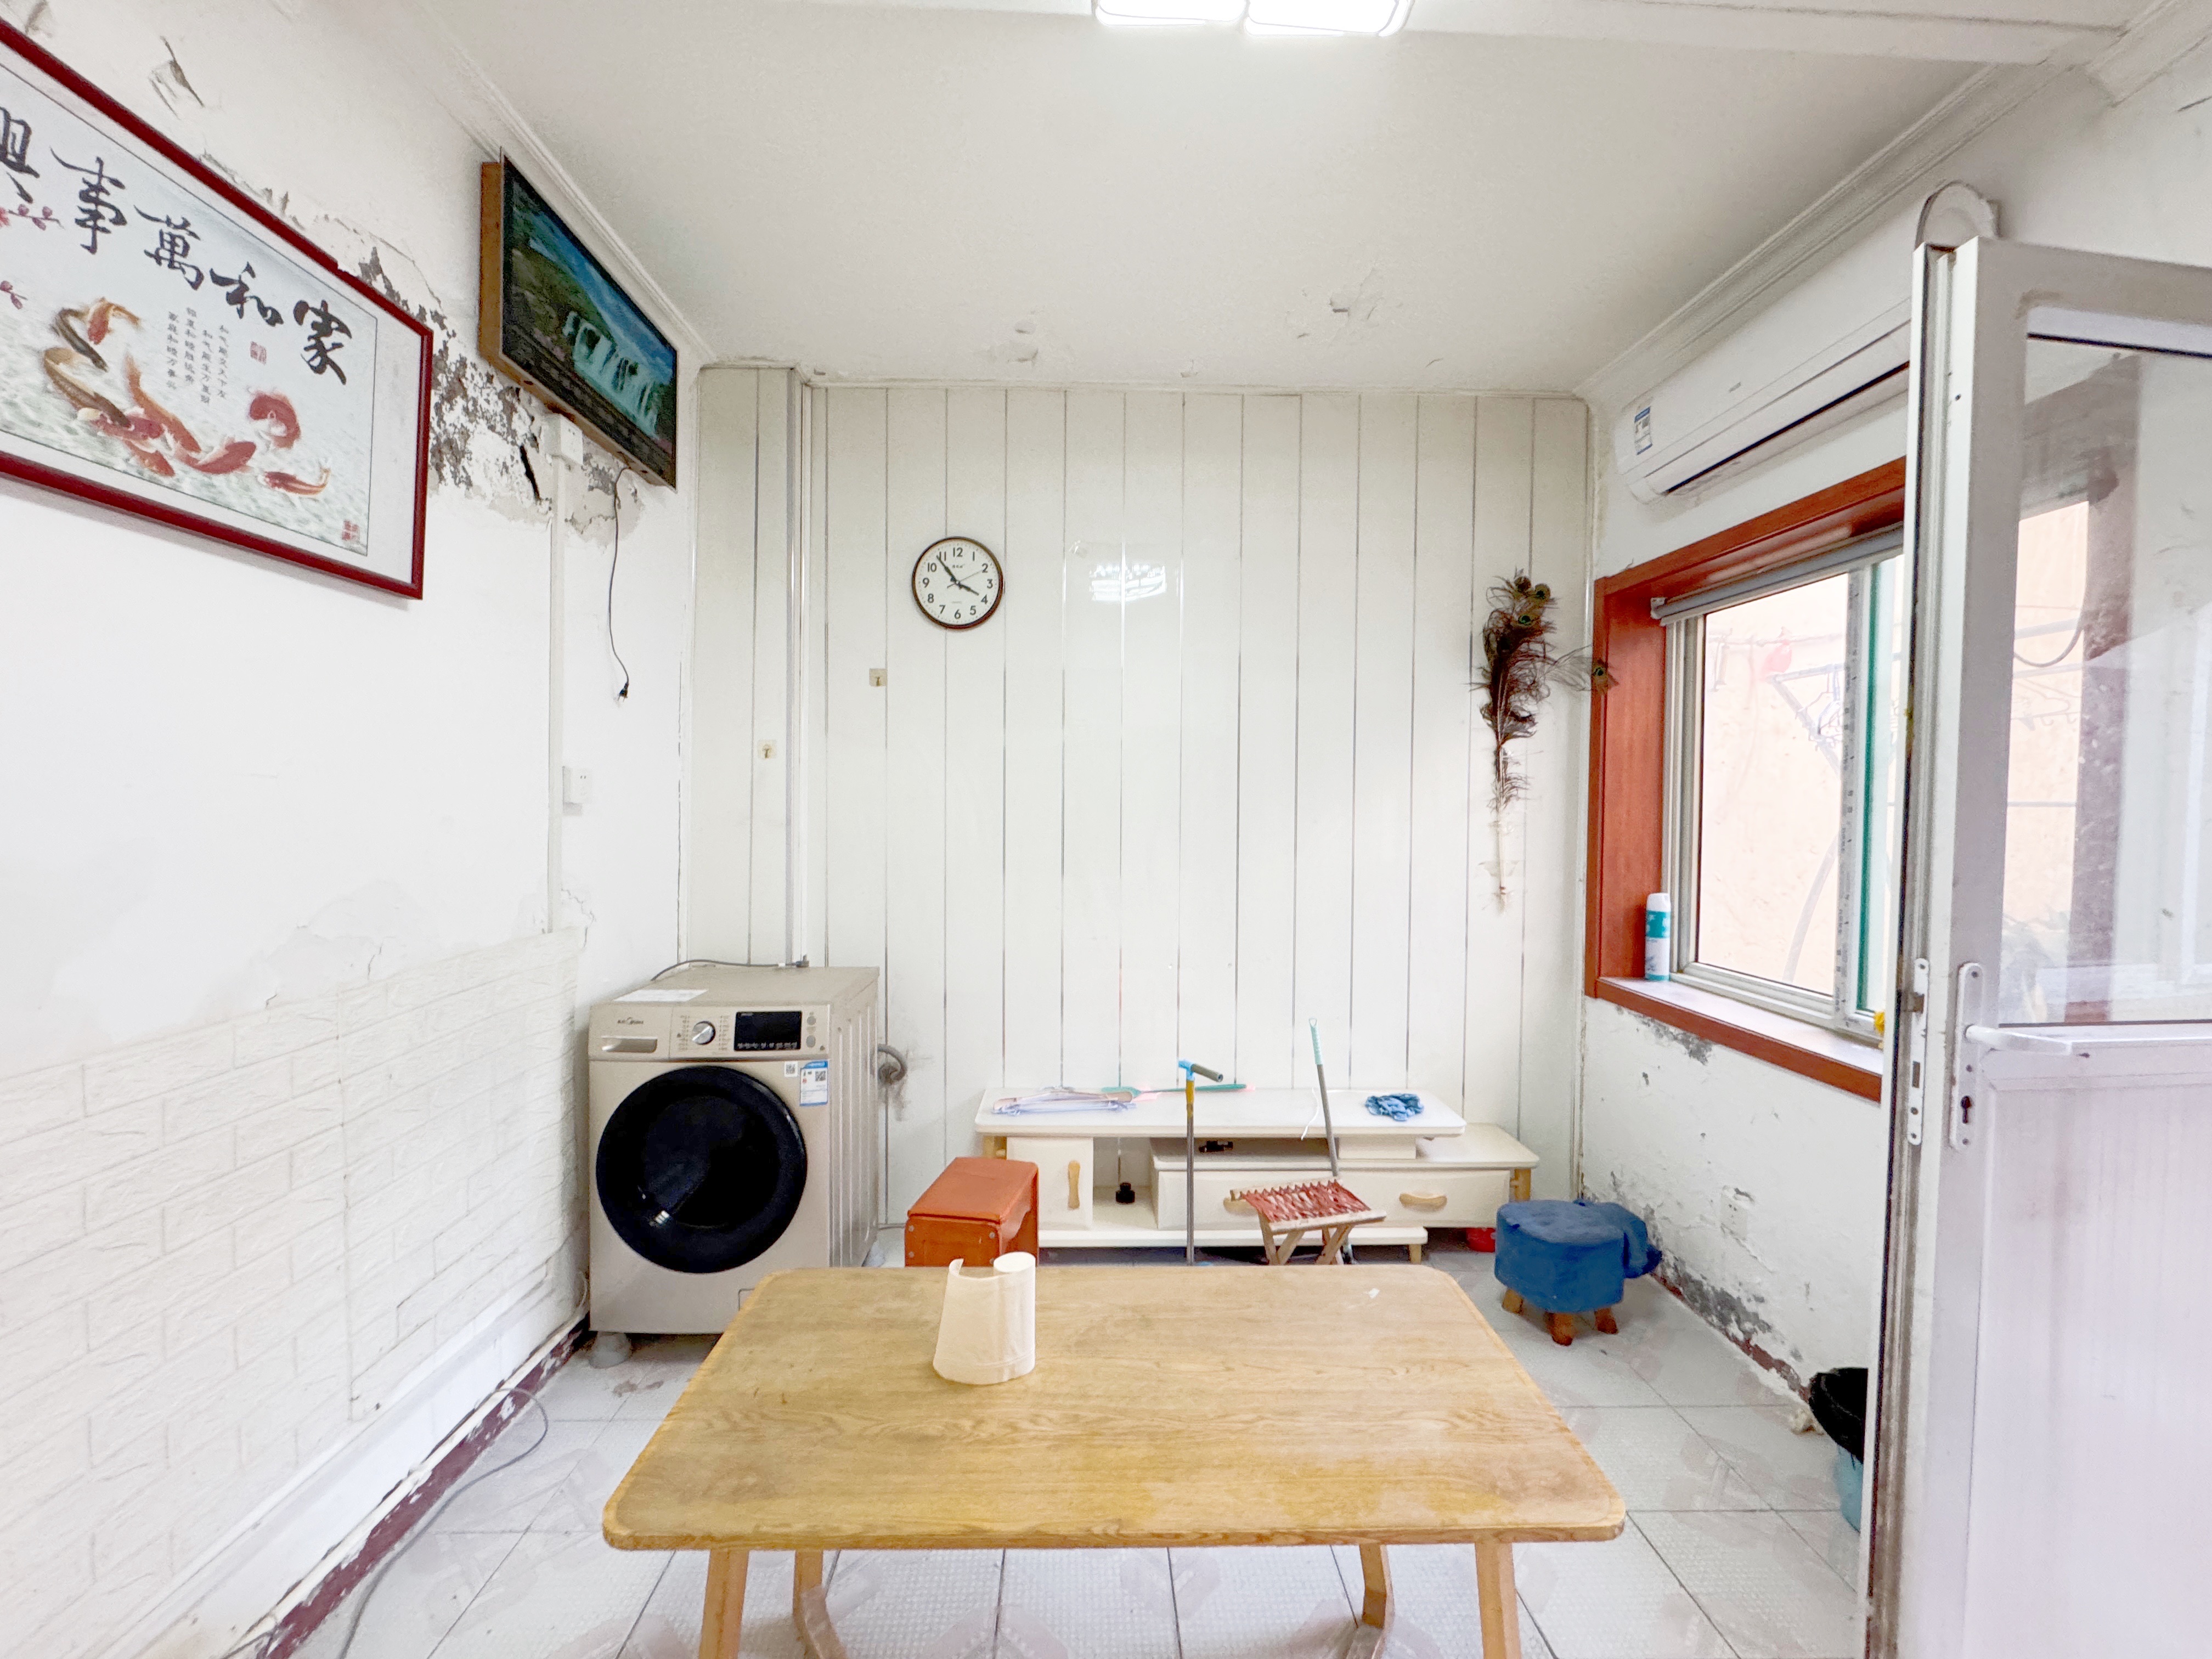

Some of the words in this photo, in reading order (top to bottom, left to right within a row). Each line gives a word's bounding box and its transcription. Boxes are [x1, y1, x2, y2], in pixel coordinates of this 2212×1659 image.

[939, 551, 946, 561] 11
[953, 548, 963, 557] 12
[973, 551, 975, 561] 1
[928, 562, 937, 572] 10
[982, 563, 988, 573] 2
[923, 578, 929, 588] 9
[987, 579, 993, 589] 3
[928, 593, 934, 603] 8
[981, 594, 988, 604] 4
[939, 605, 946, 614] 7
[954, 609, 961, 619] 6
[970, 605, 976, 616] 5
